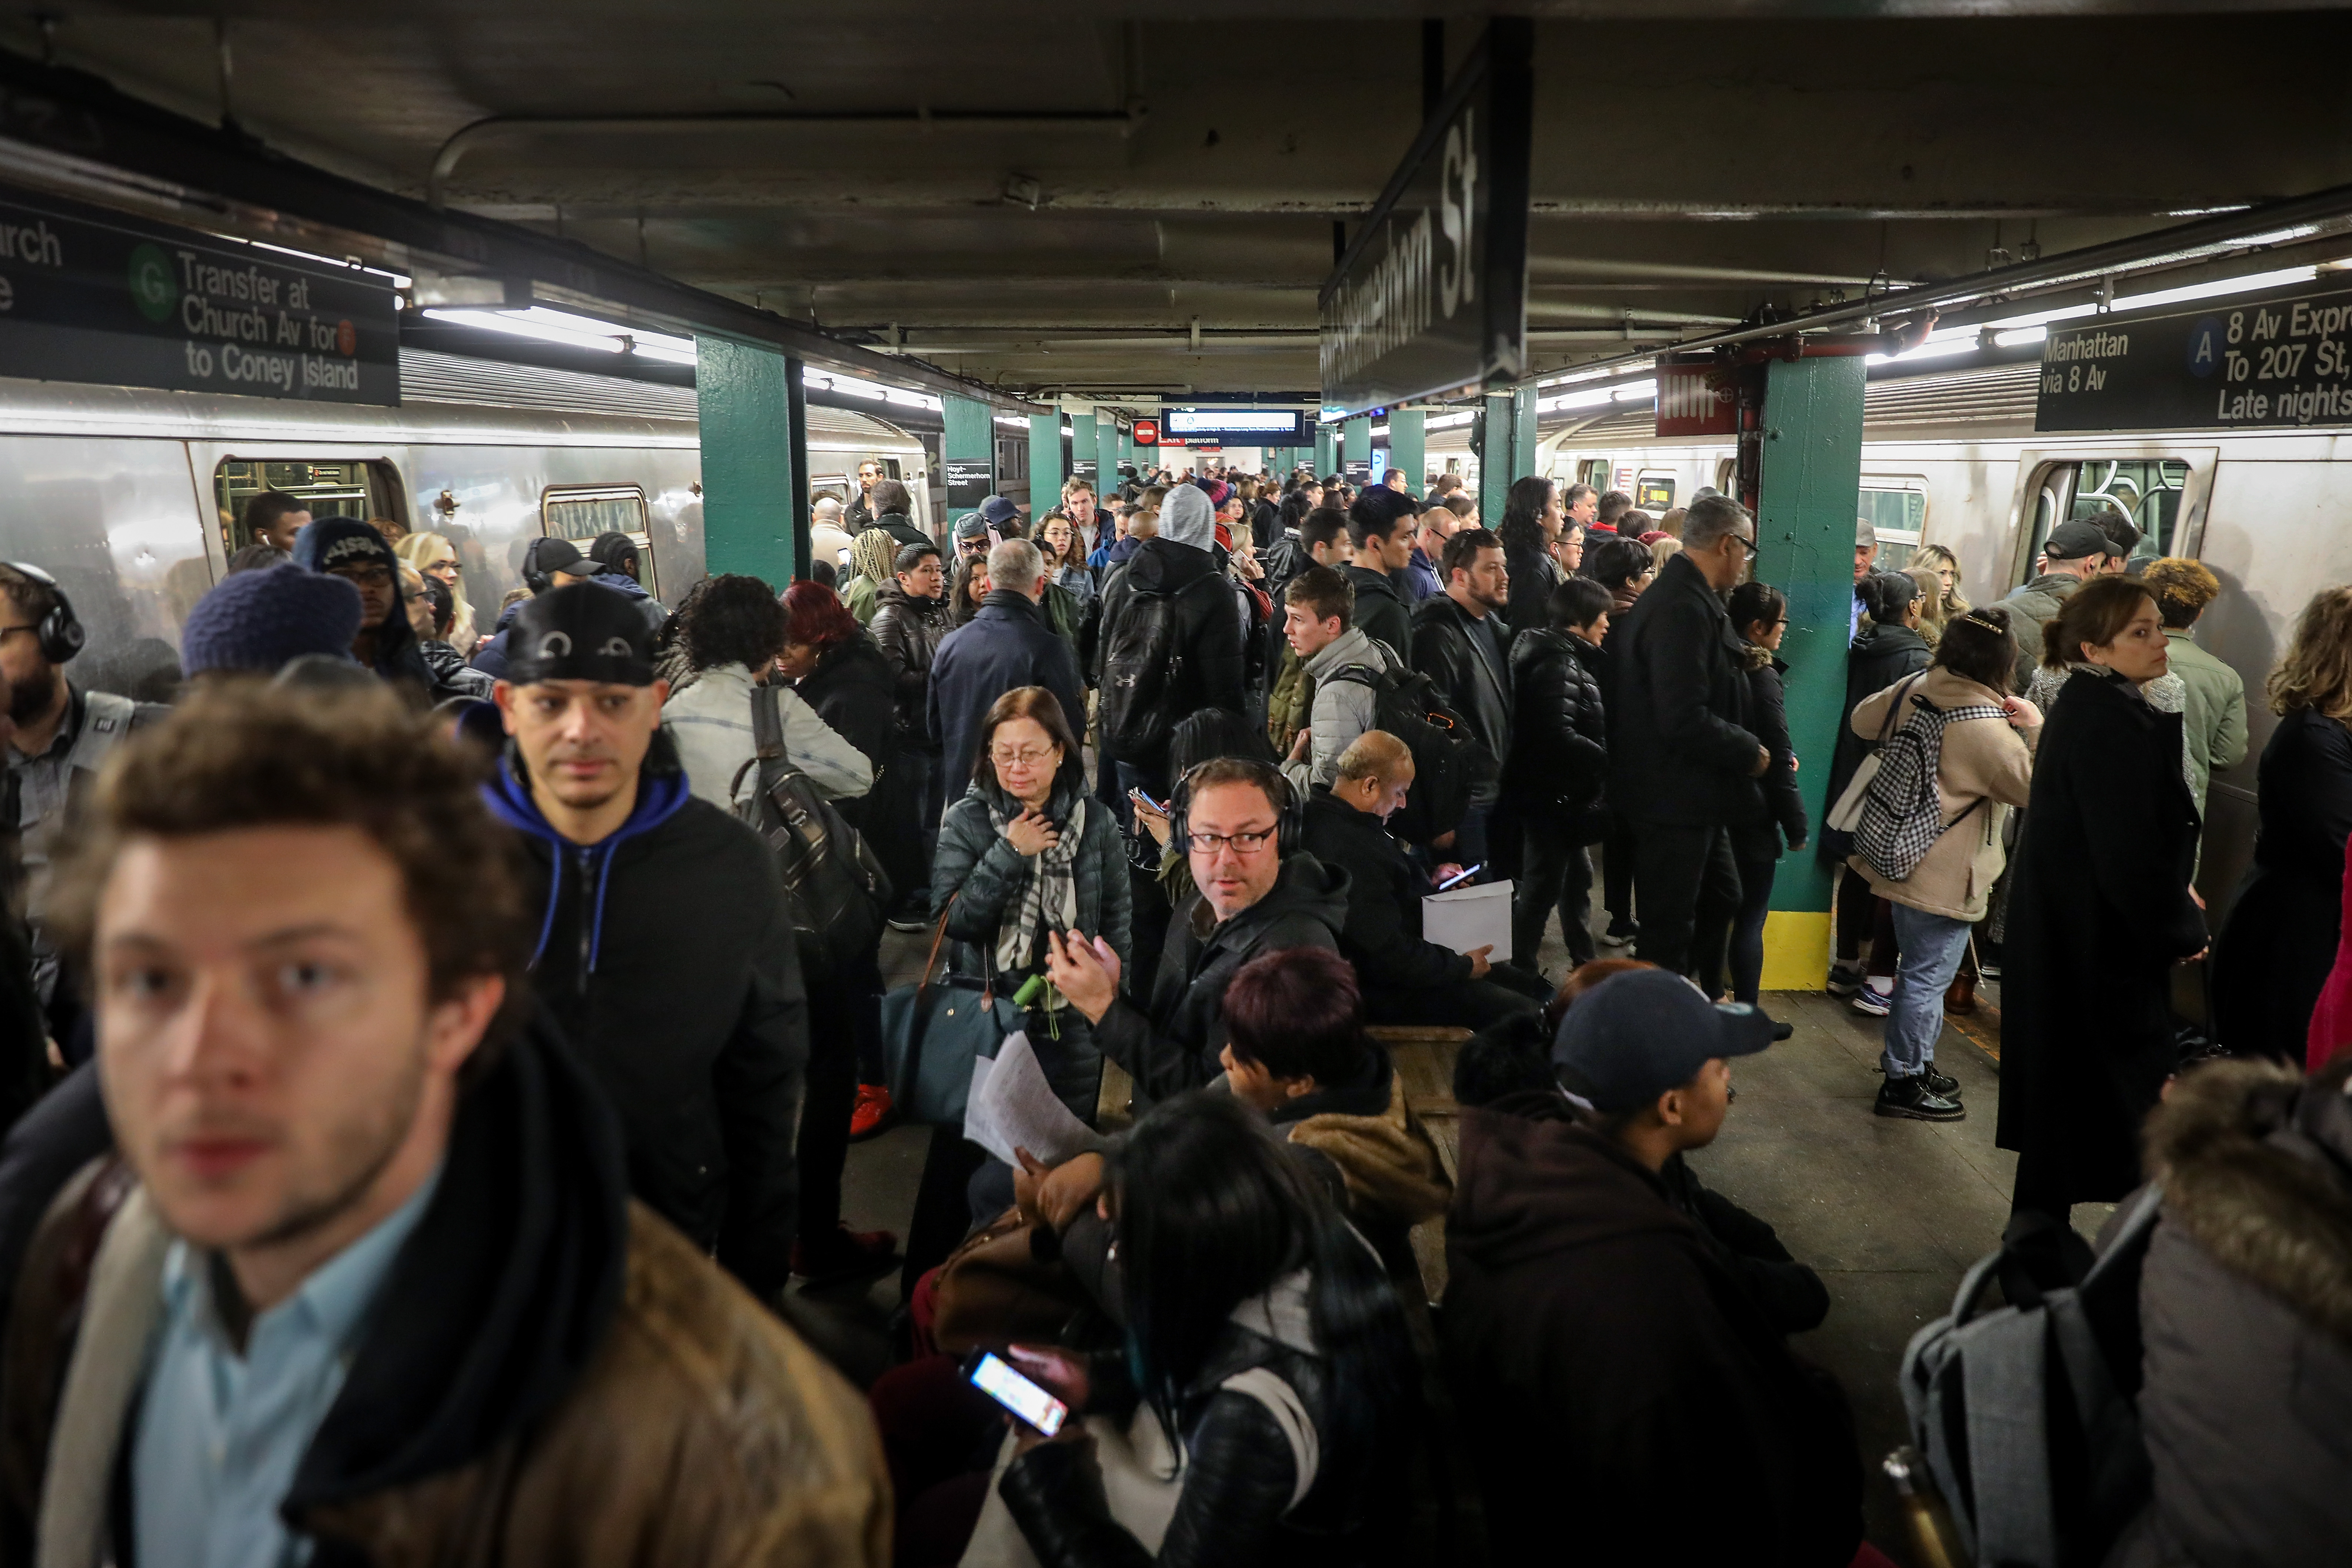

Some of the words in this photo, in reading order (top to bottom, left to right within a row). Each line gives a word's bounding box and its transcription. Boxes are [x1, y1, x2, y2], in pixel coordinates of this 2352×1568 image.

[1441, 108, 1477, 319] St
[140, 261, 166, 304] G
[177, 250, 280, 305] Transfer
[289, 278, 310, 310] at
[183, 294, 268, 342] Church
[276, 310, 301, 346] Av
[310, 315, 337, 350] for
[2227, 311, 2244, 344] 8
[2251, 308, 2282, 341] Av
[2289, 303, 2352, 340] Expr
[186, 341, 213, 378] to
[223, 343, 294, 391] Coney
[302, 353, 358, 390] Island
[2044, 332, 2128, 363] Manhattan
[2195, 331, 2212, 363] A
[2225, 350, 2249, 382] To
[2258, 344, 2308, 379] 207
[2315, 340, 2350, 381] St,
[2042, 368, 2063, 394] via
[2069, 366, 2080, 393] 8
[2085, 364, 2107, 391] Av
[2218, 389, 2269, 419] Late
[2277, 383, 2352, 423] nights
